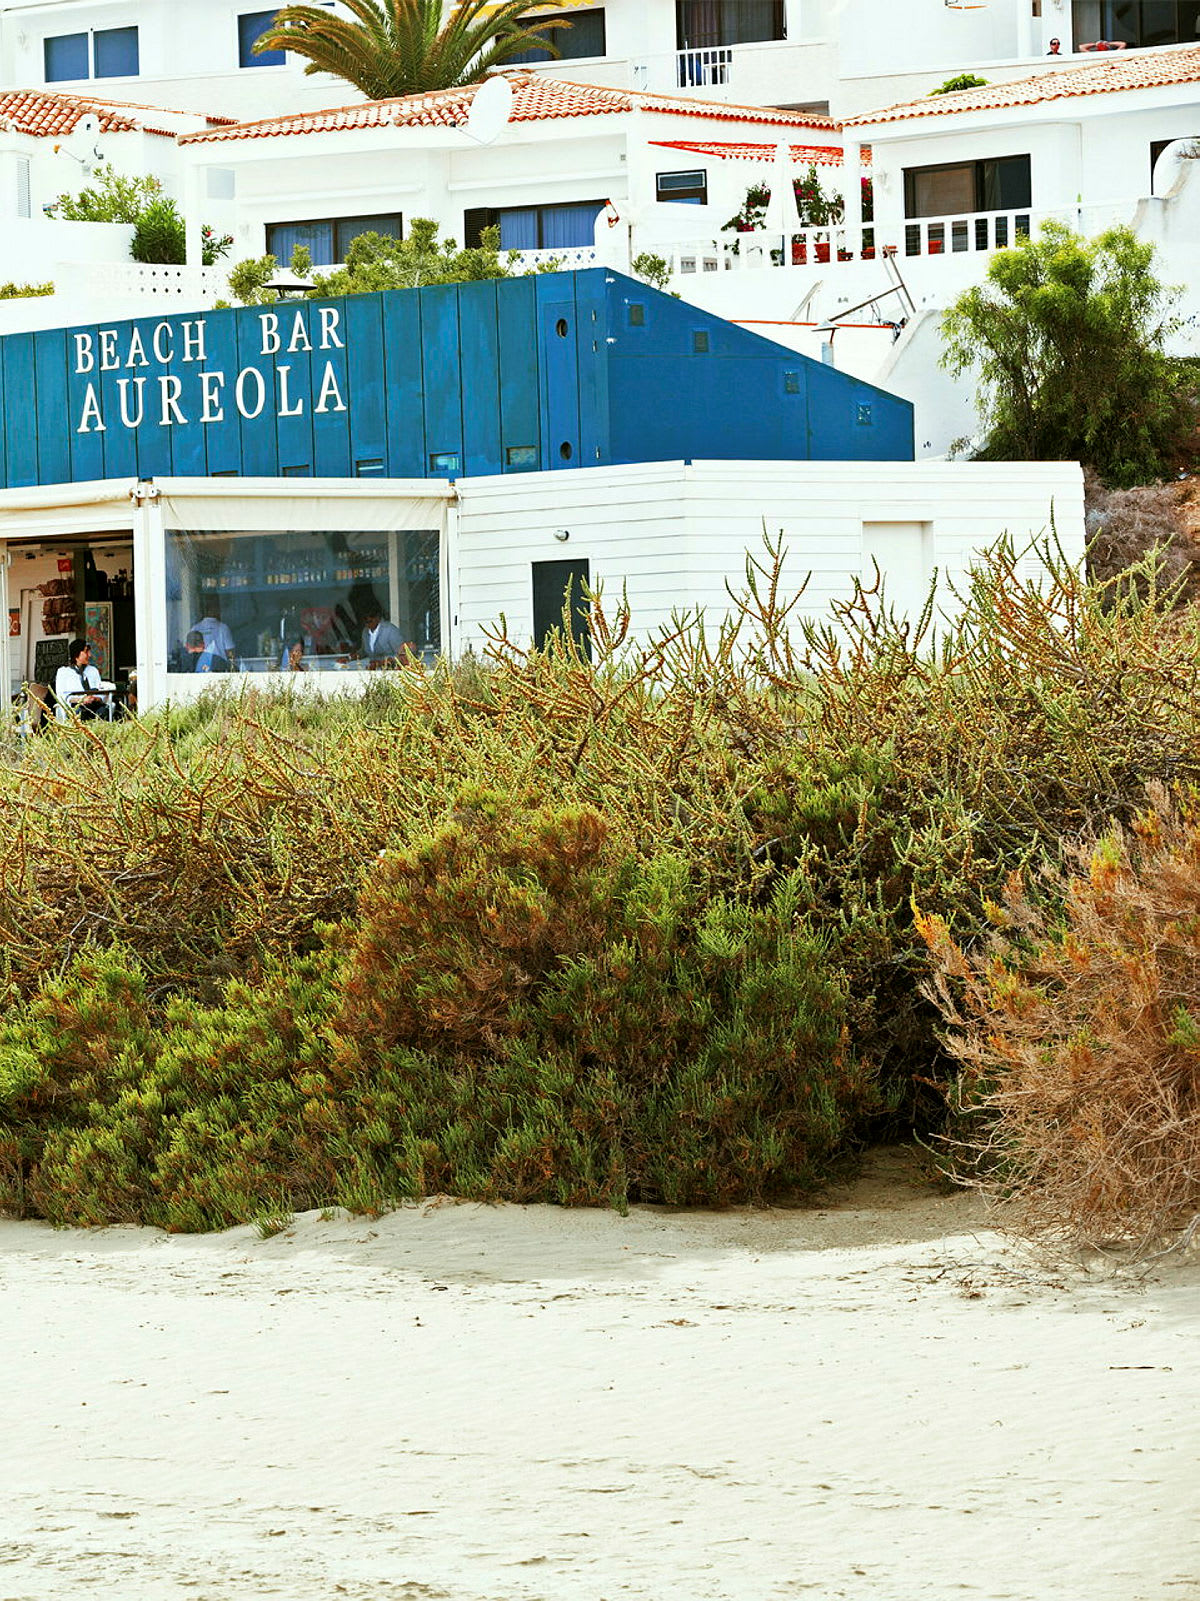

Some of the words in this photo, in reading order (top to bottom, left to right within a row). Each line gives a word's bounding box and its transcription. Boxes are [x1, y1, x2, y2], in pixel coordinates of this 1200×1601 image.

[73, 319, 207, 374] BEACH
[258, 307, 345, 355] BAR
[77, 360, 347, 433] AUREOLA
